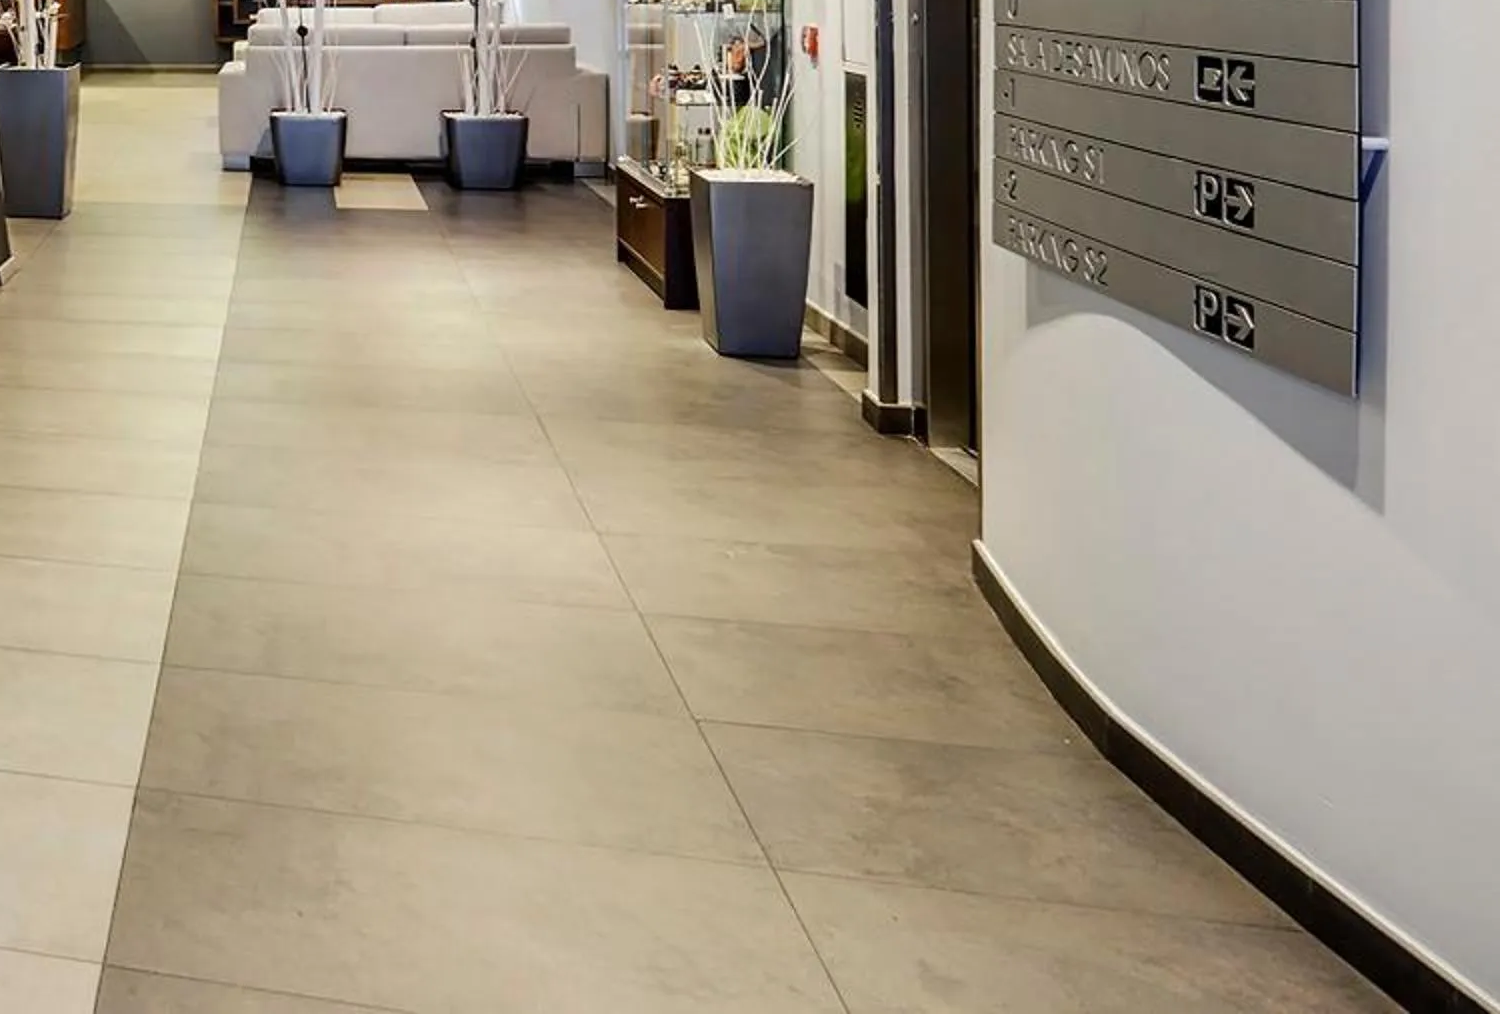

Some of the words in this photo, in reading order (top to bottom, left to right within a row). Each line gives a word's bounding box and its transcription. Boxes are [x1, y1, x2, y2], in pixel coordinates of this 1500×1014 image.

[1007, 124, 1079, 175] PARKNG
[1201, 174, 1218, 213] P
[1007, 215, 1079, 273] PARKNG
[1083, 246, 1110, 287] S2
[1200, 289, 1218, 328] P
